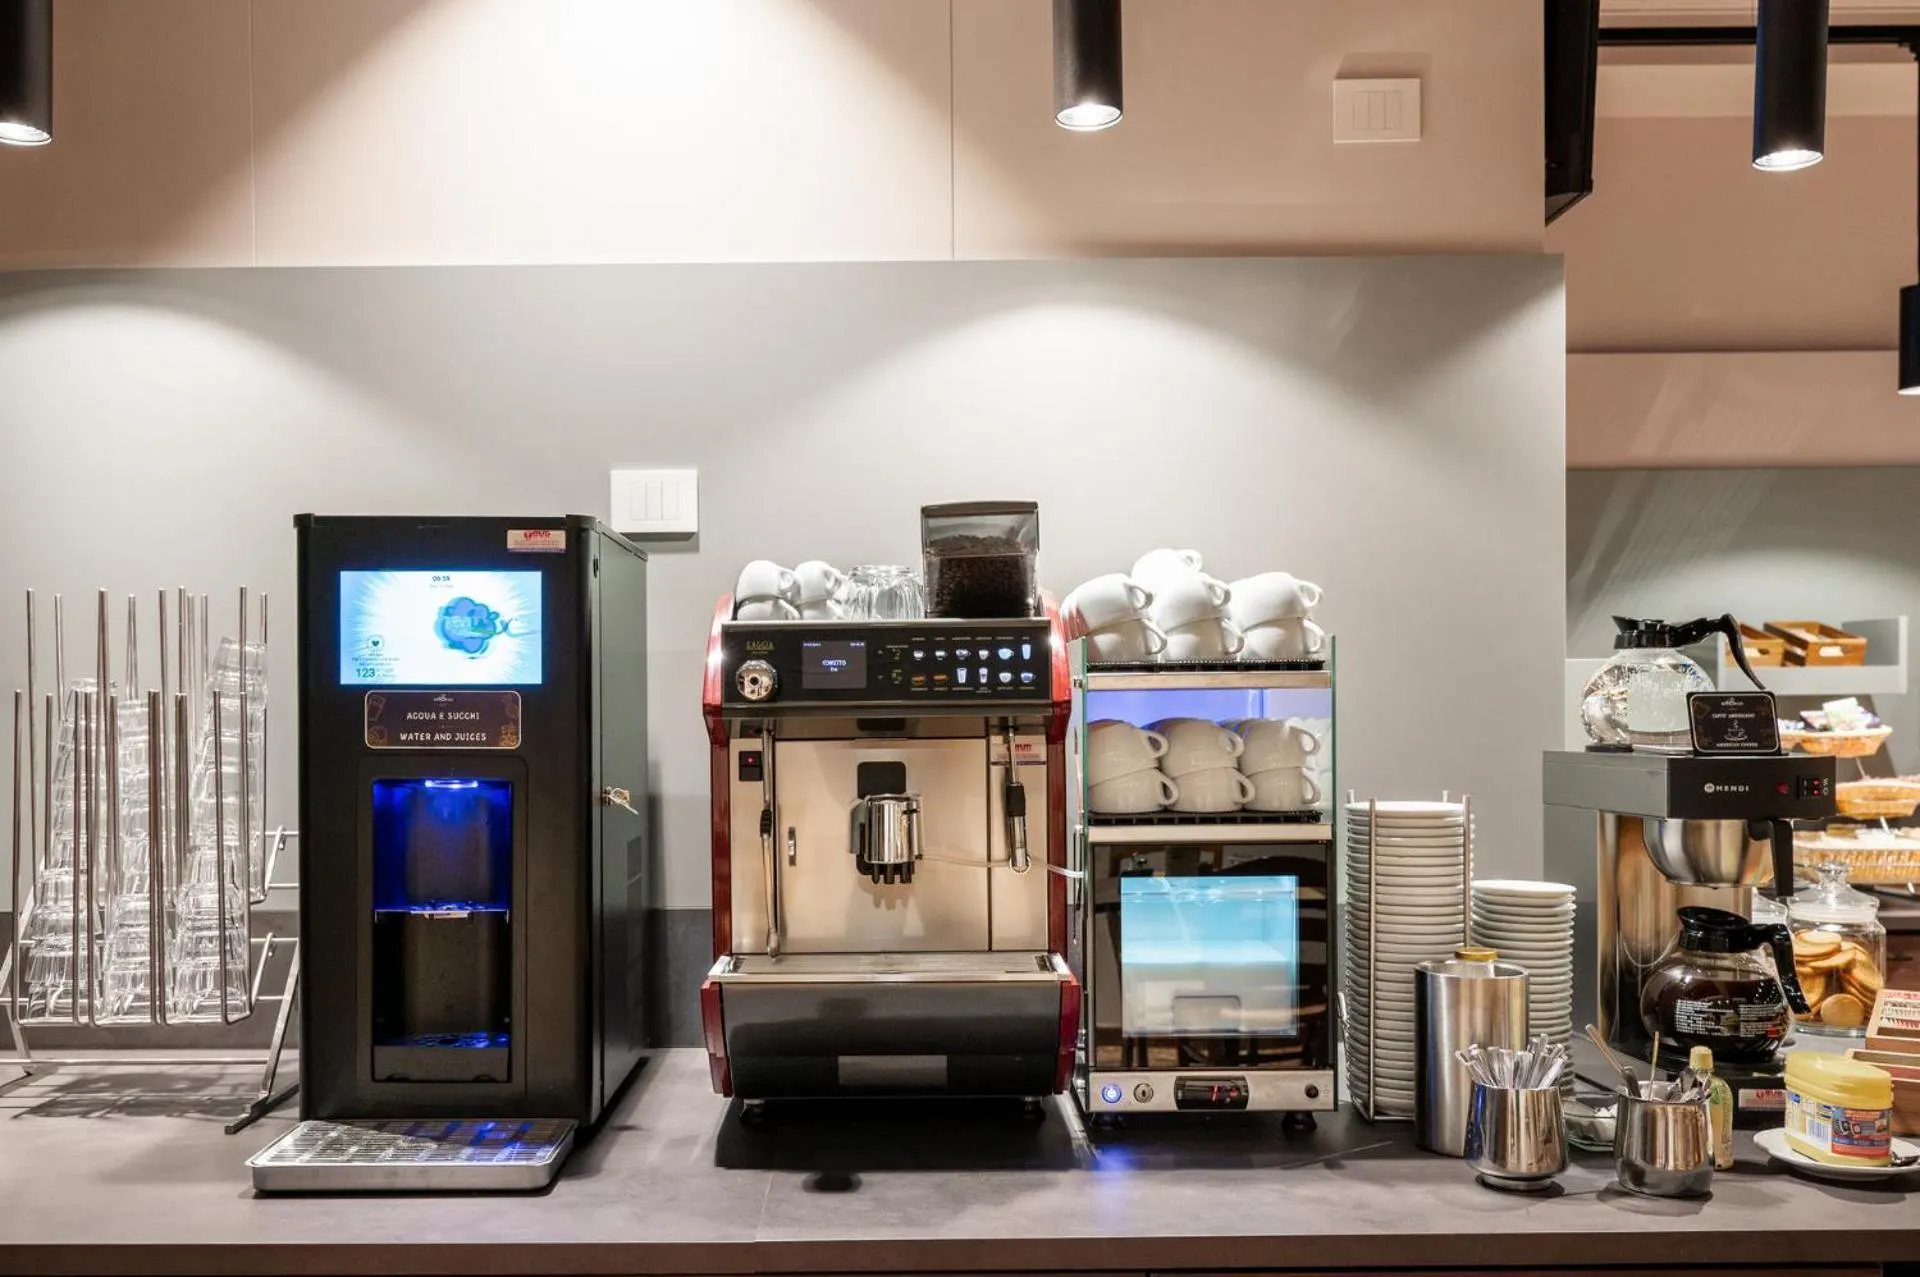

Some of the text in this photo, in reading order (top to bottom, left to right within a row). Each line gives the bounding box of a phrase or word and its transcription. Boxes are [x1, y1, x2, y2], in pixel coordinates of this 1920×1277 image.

[356, 667, 376, 678] 123
[406, 712, 480, 720] ACQUA E SUCCHI
[400, 732, 487, 741] WATER AND JUICES
